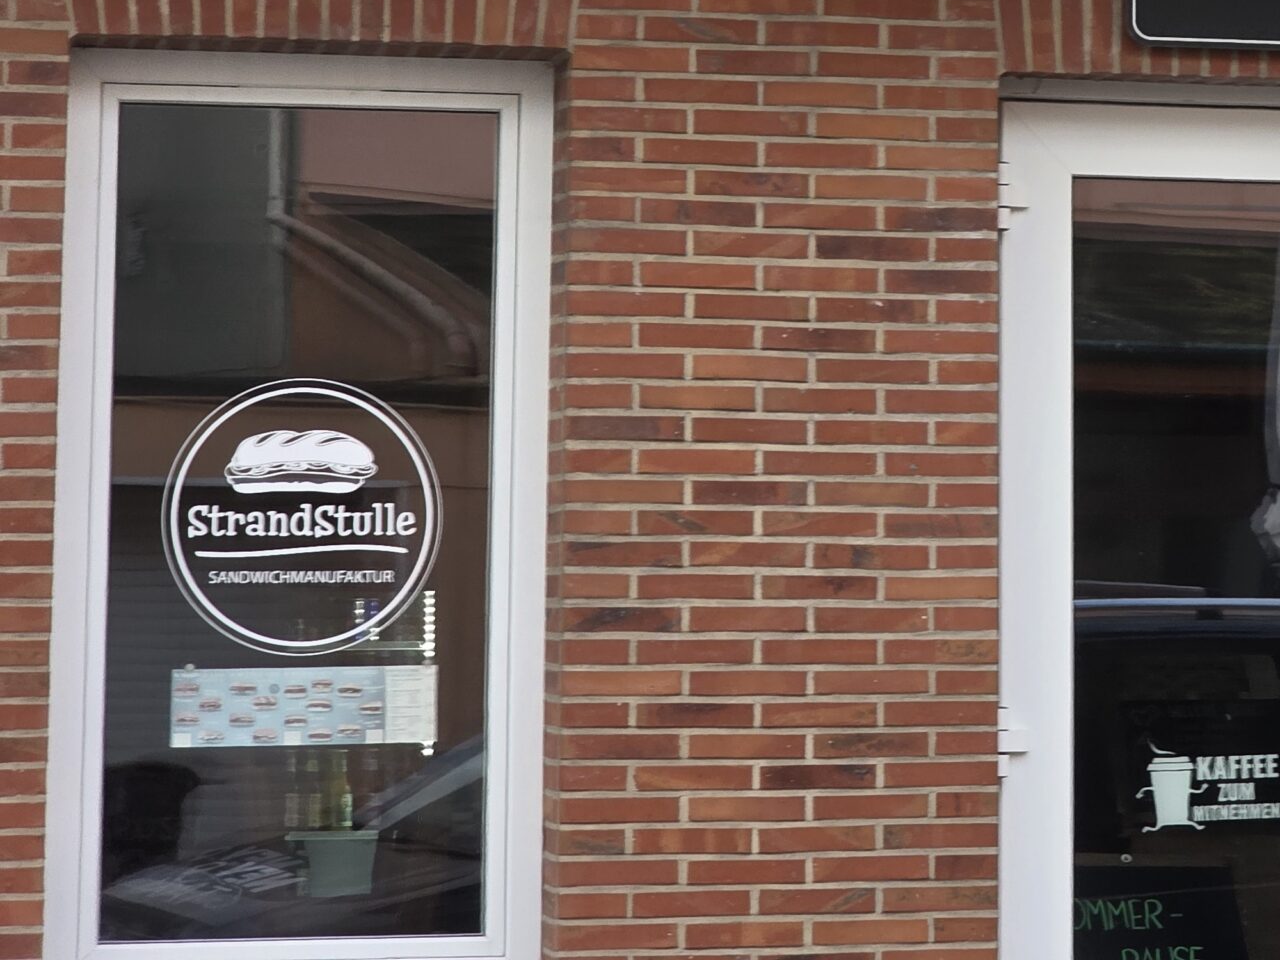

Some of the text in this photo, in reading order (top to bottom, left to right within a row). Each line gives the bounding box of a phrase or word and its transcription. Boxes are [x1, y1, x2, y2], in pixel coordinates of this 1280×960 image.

[187, 503, 418, 538] StrandStulle
[208, 570, 395, 584] SANDWICHMANUFAKTUR
[1196, 754, 1280, 780] KAFFEE
[1217, 782, 1255, 801] ZUM
